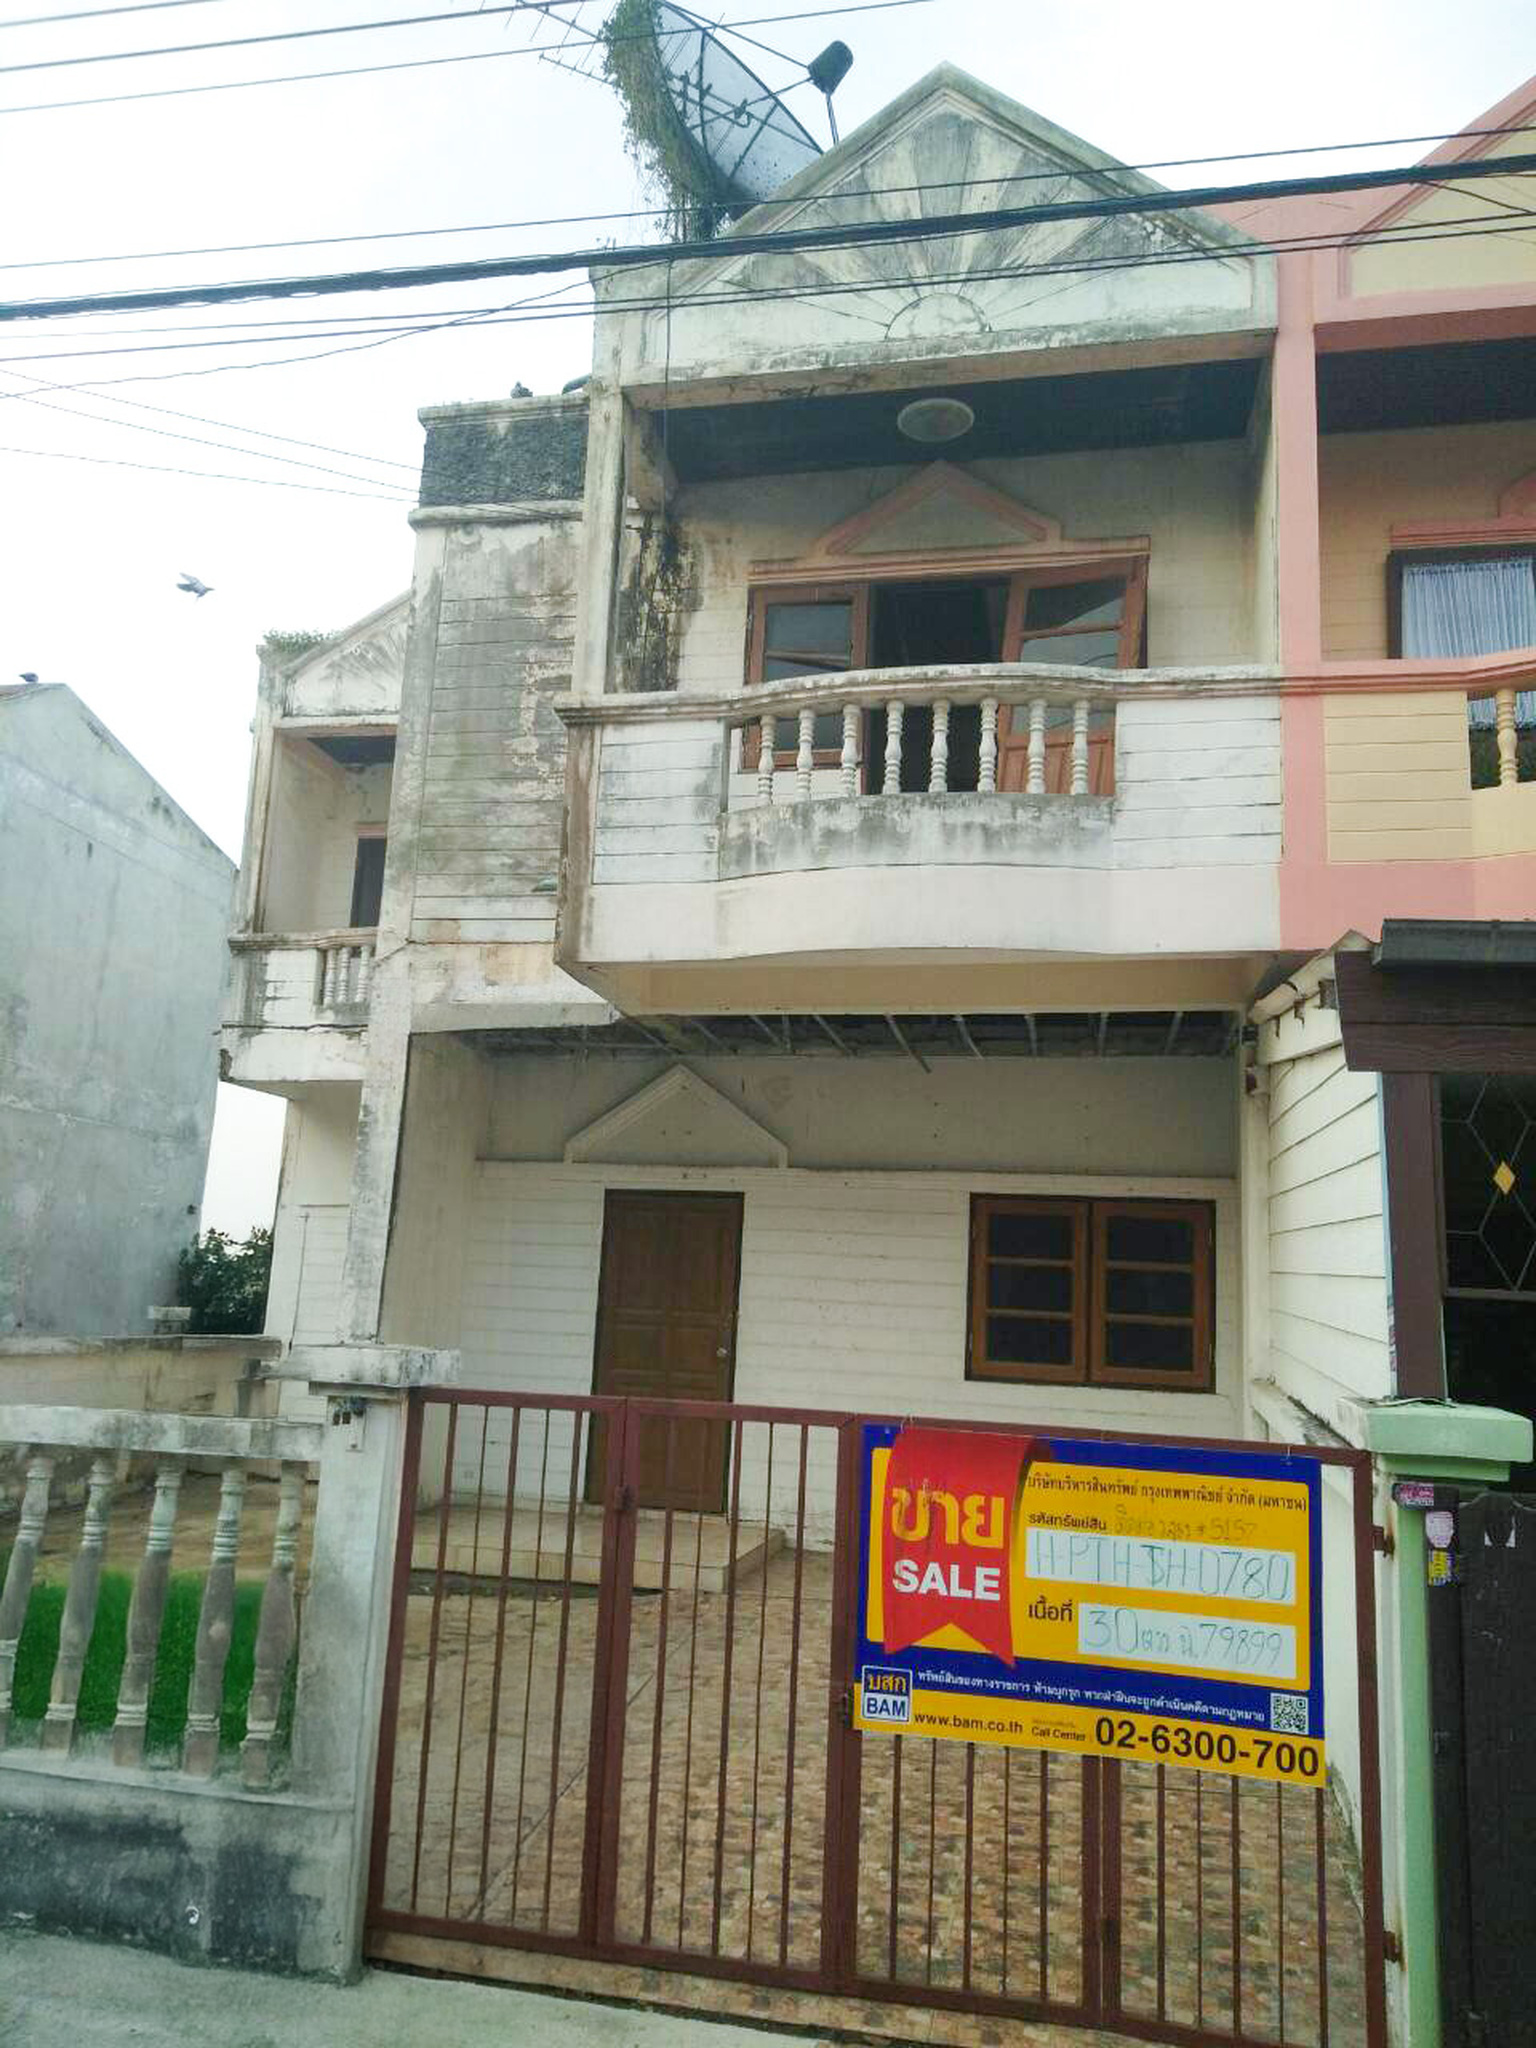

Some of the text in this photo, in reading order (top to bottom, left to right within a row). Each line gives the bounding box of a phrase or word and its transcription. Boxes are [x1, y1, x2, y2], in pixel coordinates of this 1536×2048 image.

[892, 1486, 1005, 1549] ขาย
[892, 1559, 1001, 1601] SALE
[1028, 1594, 1073, 1622] เนื้อที่
[867, 1673, 907, 1693] บสก
[866, 1698, 907, 1718] BAM
[914, 1712, 1024, 1734] www.bam.co.th
[1031, 1725, 1086, 1742] Call Center
[1095, 1717, 1320, 1777] 02-6300-700
